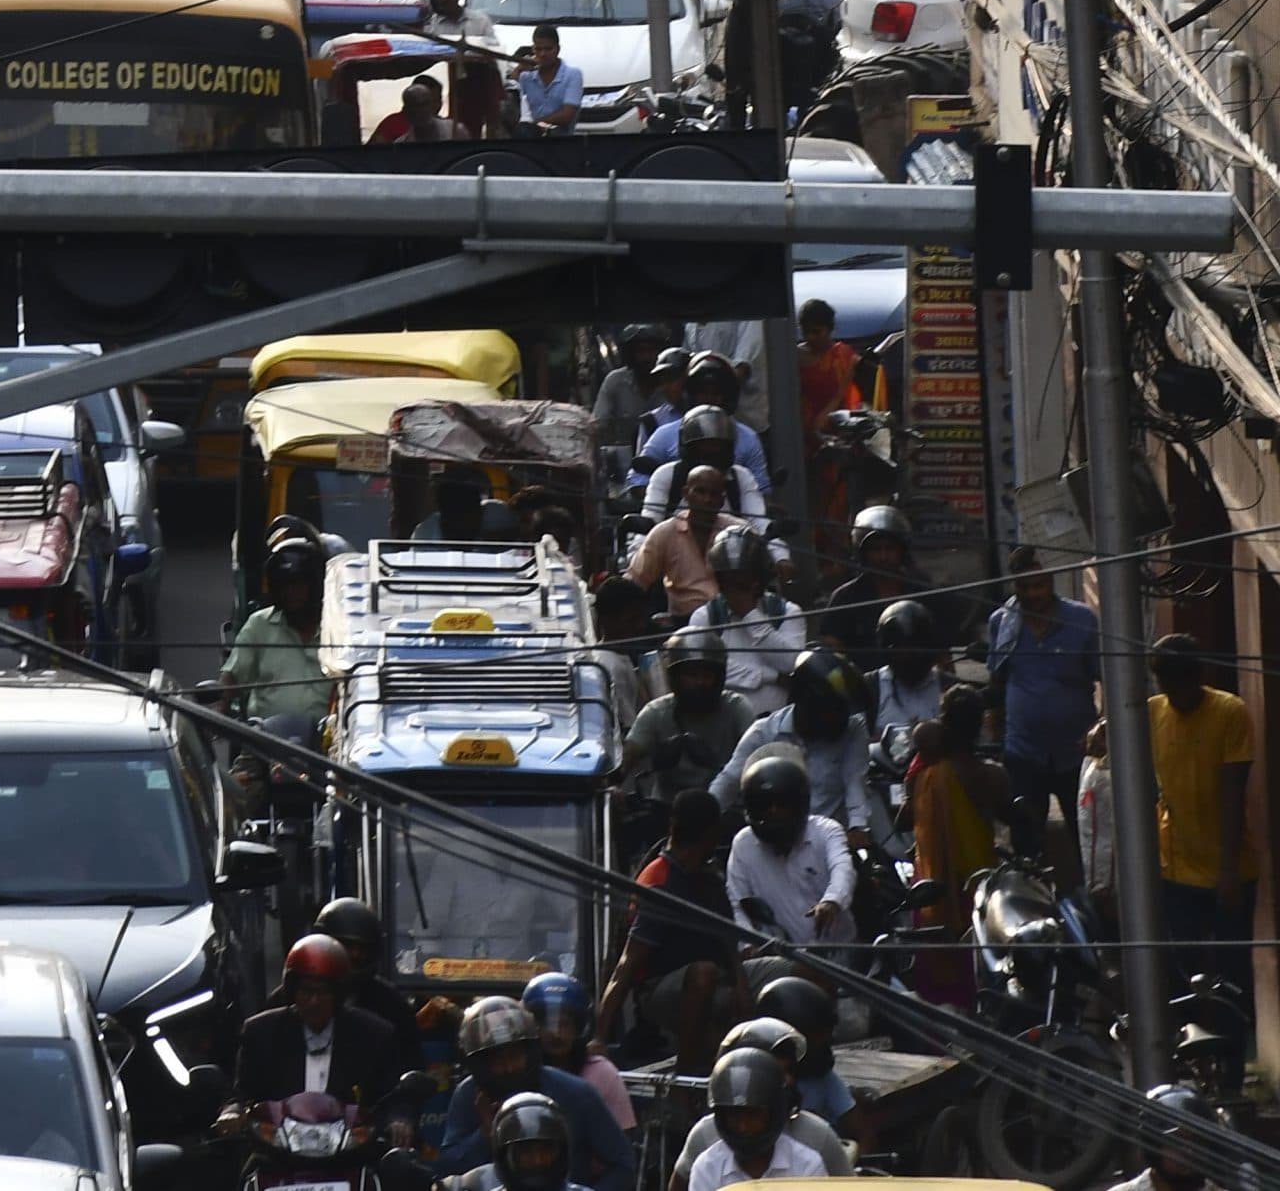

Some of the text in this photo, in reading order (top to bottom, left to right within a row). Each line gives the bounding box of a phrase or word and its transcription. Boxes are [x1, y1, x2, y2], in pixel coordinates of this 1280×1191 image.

[5, 61, 111, 90] COLLEGE
[116, 62, 147, 90] OF
[151, 62, 282, 97] EDUCATION
